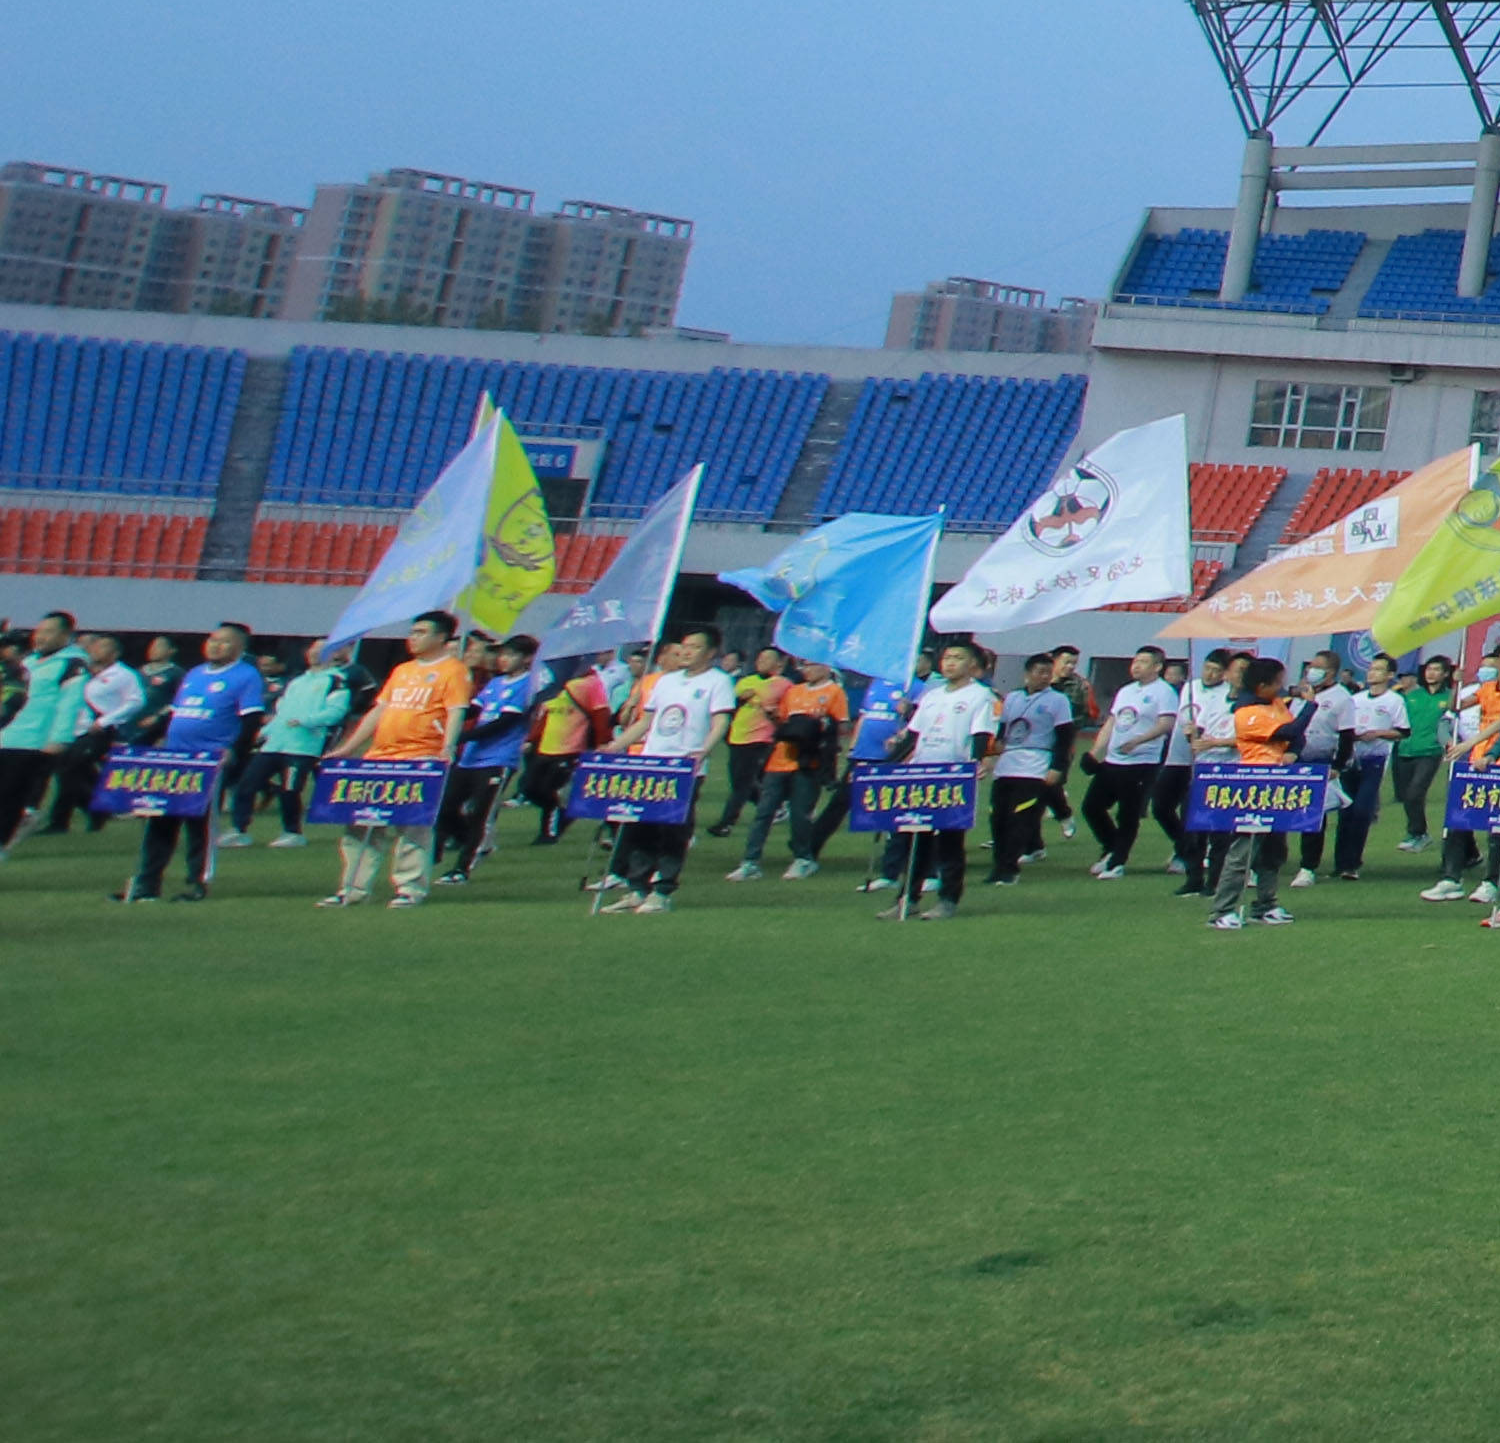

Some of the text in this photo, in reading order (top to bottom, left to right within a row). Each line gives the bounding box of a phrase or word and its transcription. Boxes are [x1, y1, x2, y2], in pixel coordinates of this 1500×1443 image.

[1204, 784, 1313, 813] 同路人足球俱乐部
